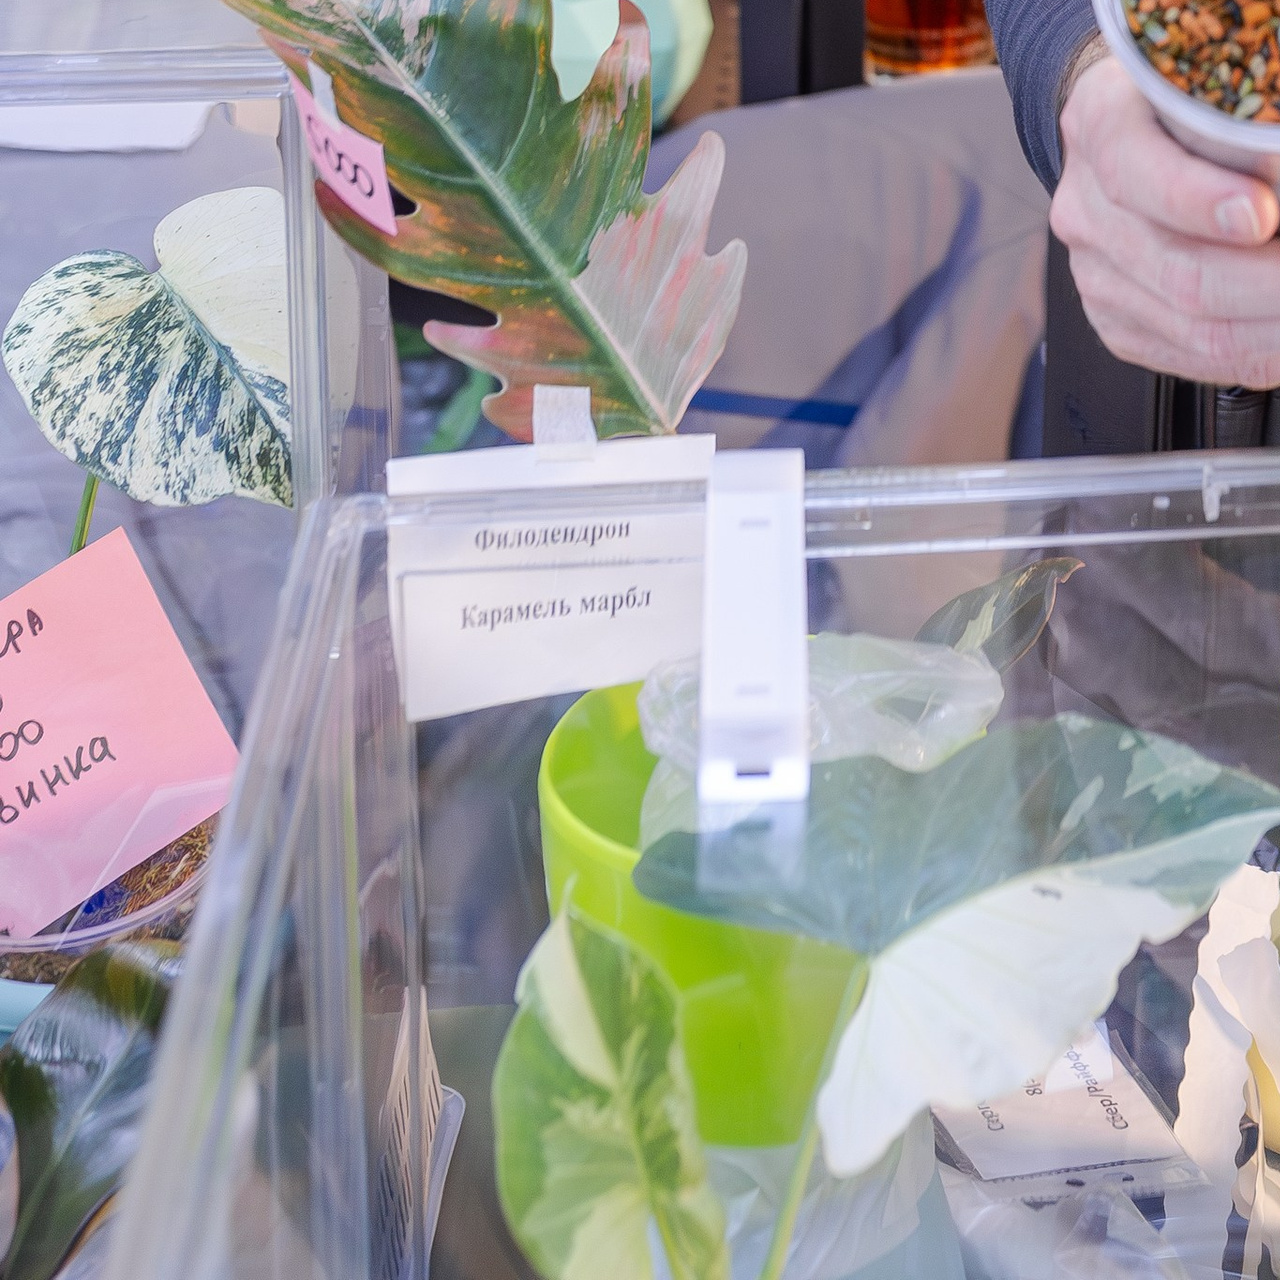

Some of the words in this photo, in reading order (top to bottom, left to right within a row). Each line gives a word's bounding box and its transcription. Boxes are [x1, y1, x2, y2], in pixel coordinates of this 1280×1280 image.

[474, 520, 631, 552] Филодендрон
[460, 598, 572, 632] Карамель
[578, 585, 652, 619] марбл
